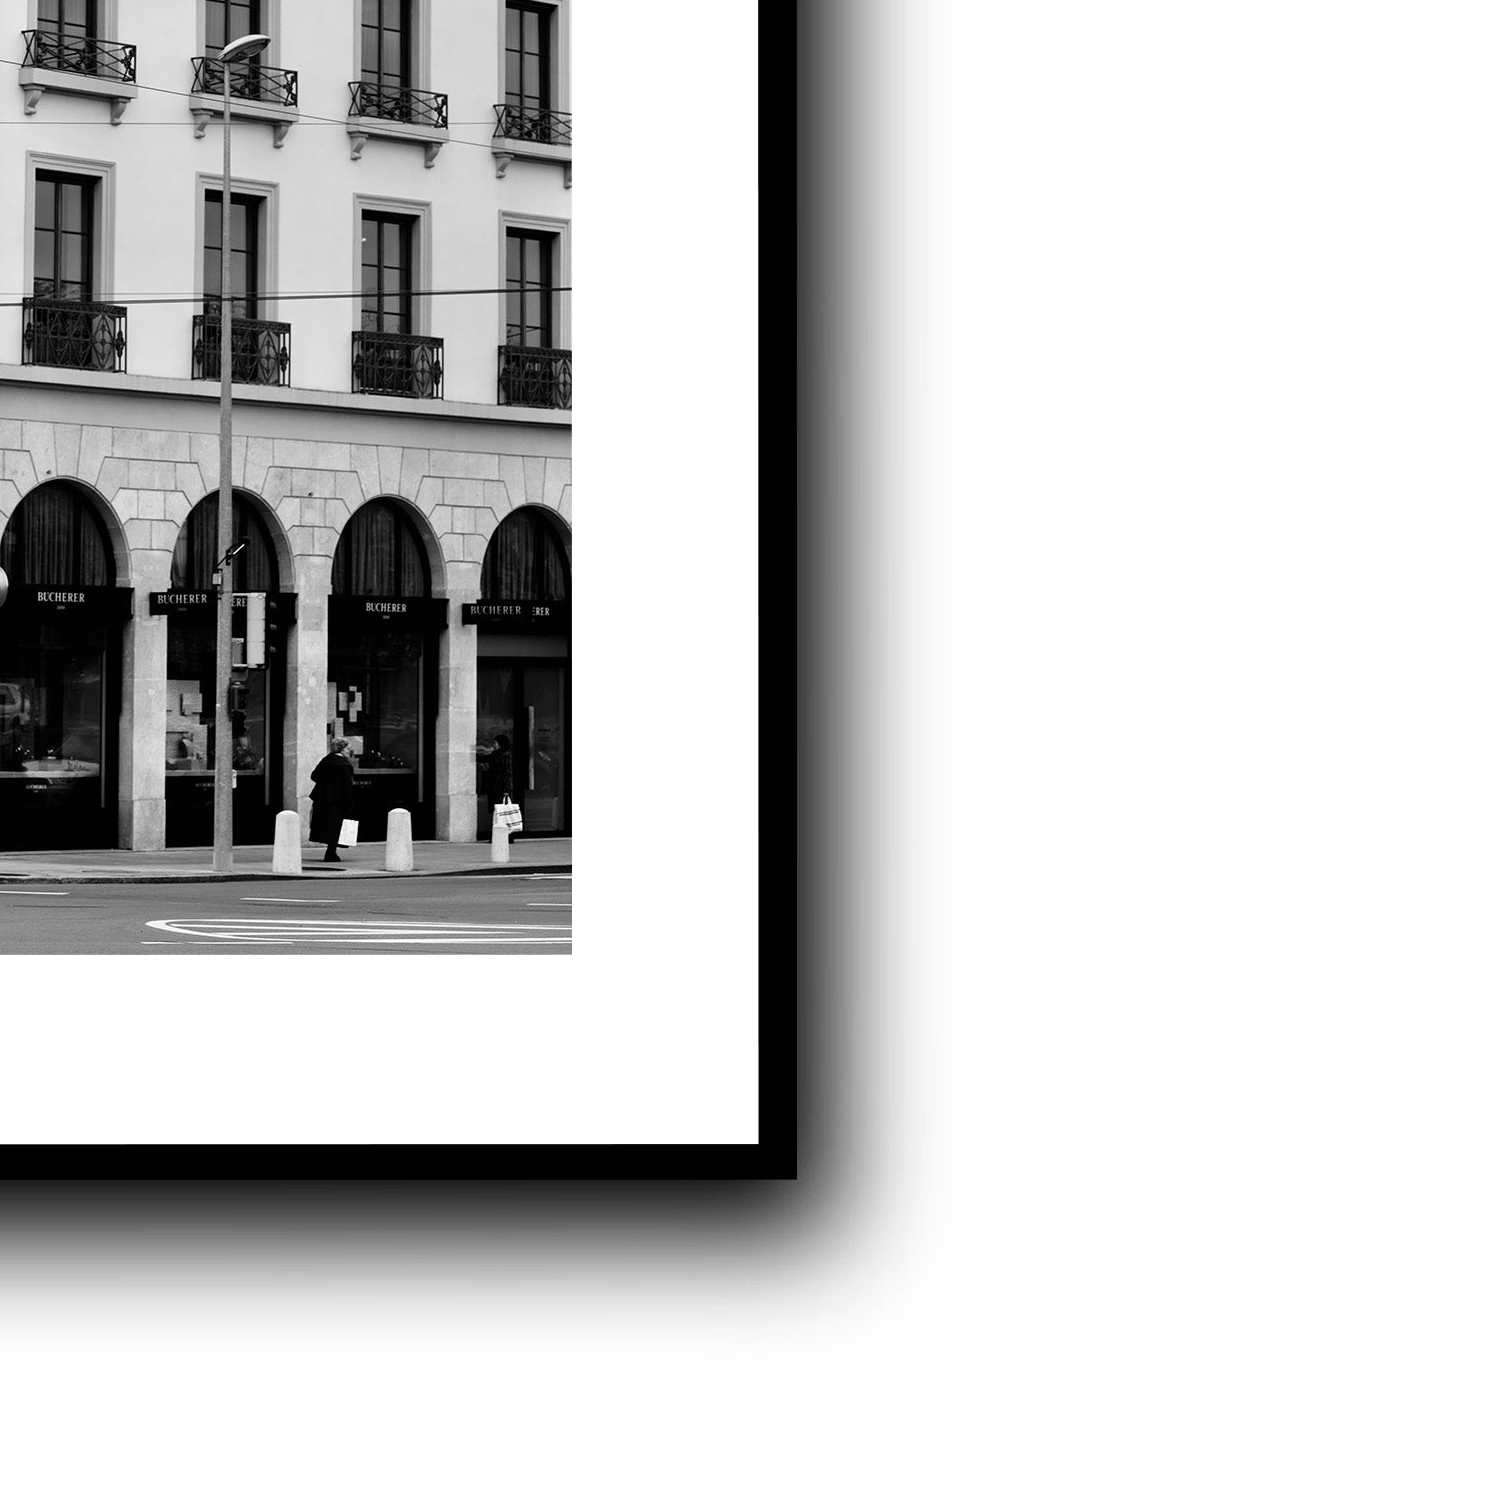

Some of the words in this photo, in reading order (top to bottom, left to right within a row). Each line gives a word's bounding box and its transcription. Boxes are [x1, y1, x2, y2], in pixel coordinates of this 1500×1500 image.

[37, 591, 85, 603] BUCHERER
[157, 594, 208, 604] BUCHERER
[365, 602, 407, 613] BUCHERER
[470, 605, 522, 615] BUCHERER
